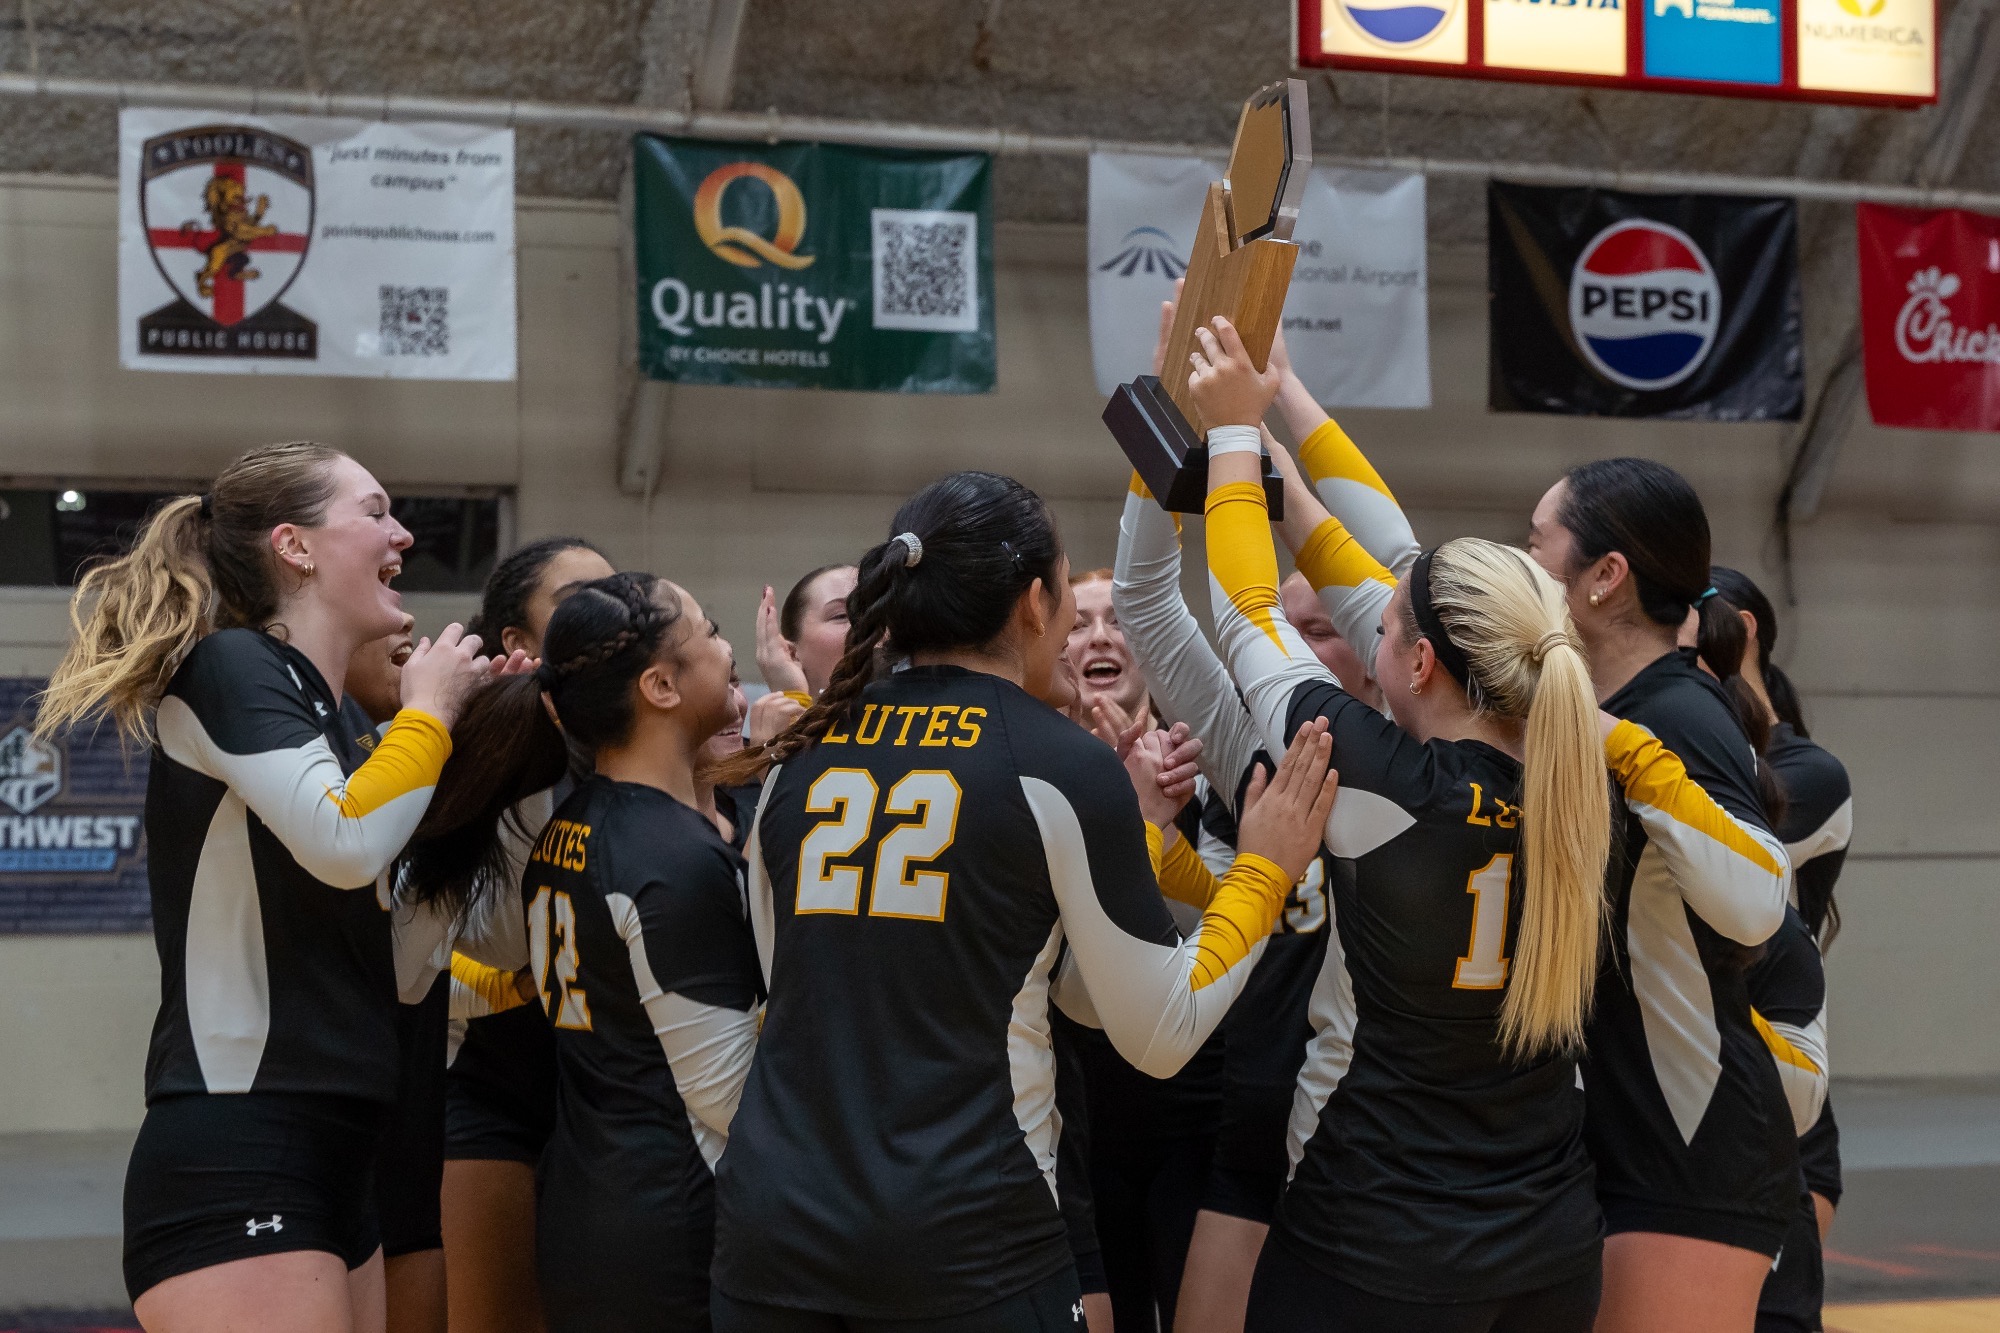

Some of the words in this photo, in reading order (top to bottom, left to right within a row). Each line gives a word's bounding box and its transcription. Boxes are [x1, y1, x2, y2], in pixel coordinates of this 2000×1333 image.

[374, 146, 449, 164] minutes
[455, 149, 502, 165] from
[1351, 267, 1420, 289] Airport
[652, 277, 846, 344] Quality
[1581, 285, 1710, 323] PEPSI
[147, 328, 228, 349] PUBLIC
[237, 331, 309, 350] HOUSE
[694, 347, 760, 365] CHOICE
[763, 350, 830, 368] HOTELS
[795, 767, 963, 922] 22
[527, 885, 594, 1032] 12
